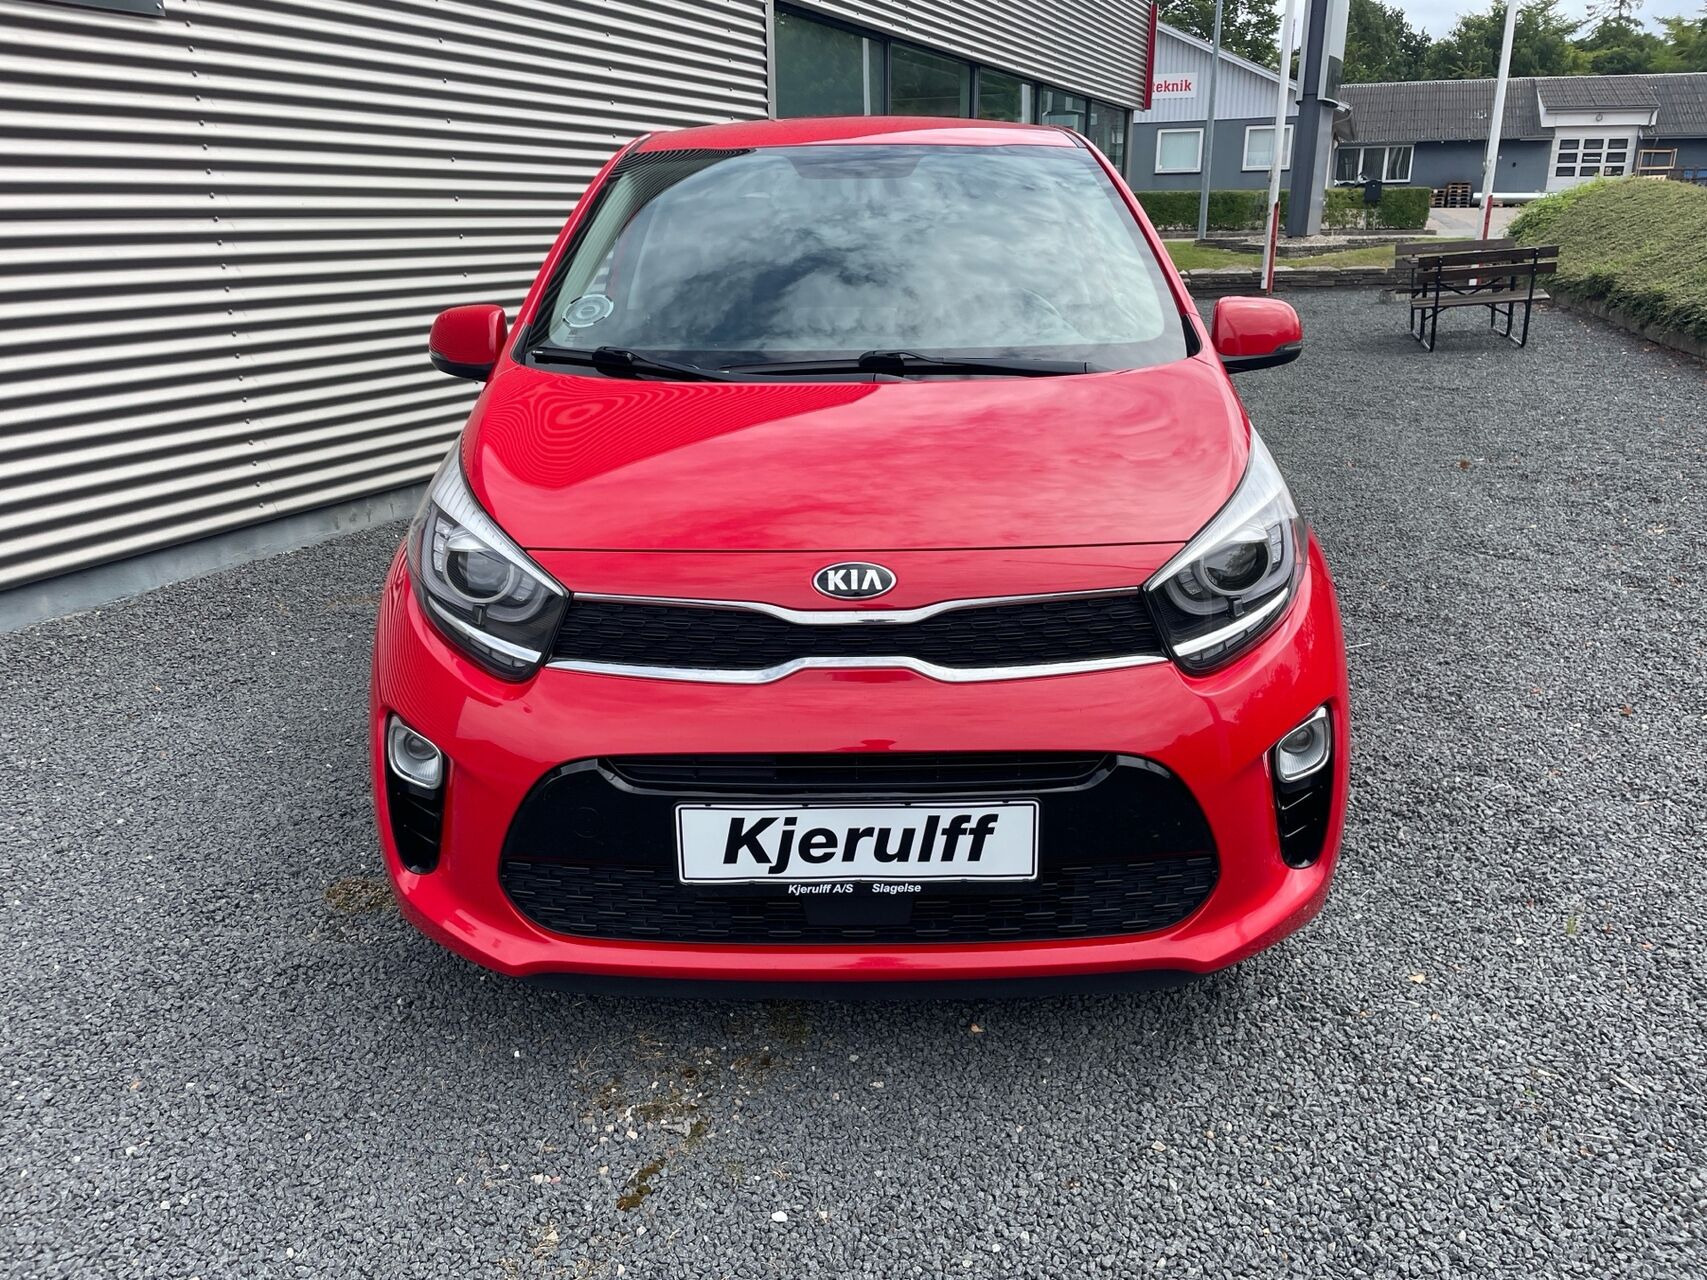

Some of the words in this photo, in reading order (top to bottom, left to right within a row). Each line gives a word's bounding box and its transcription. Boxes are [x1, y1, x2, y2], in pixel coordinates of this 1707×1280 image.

[826, 569, 883, 591] KIA
[722, 814, 999, 875] Kjerulff
[788, 884, 831, 896] Kjerulff
[832, 883, 854, 894] A/S
[872, 883, 922, 895] Slagelse
